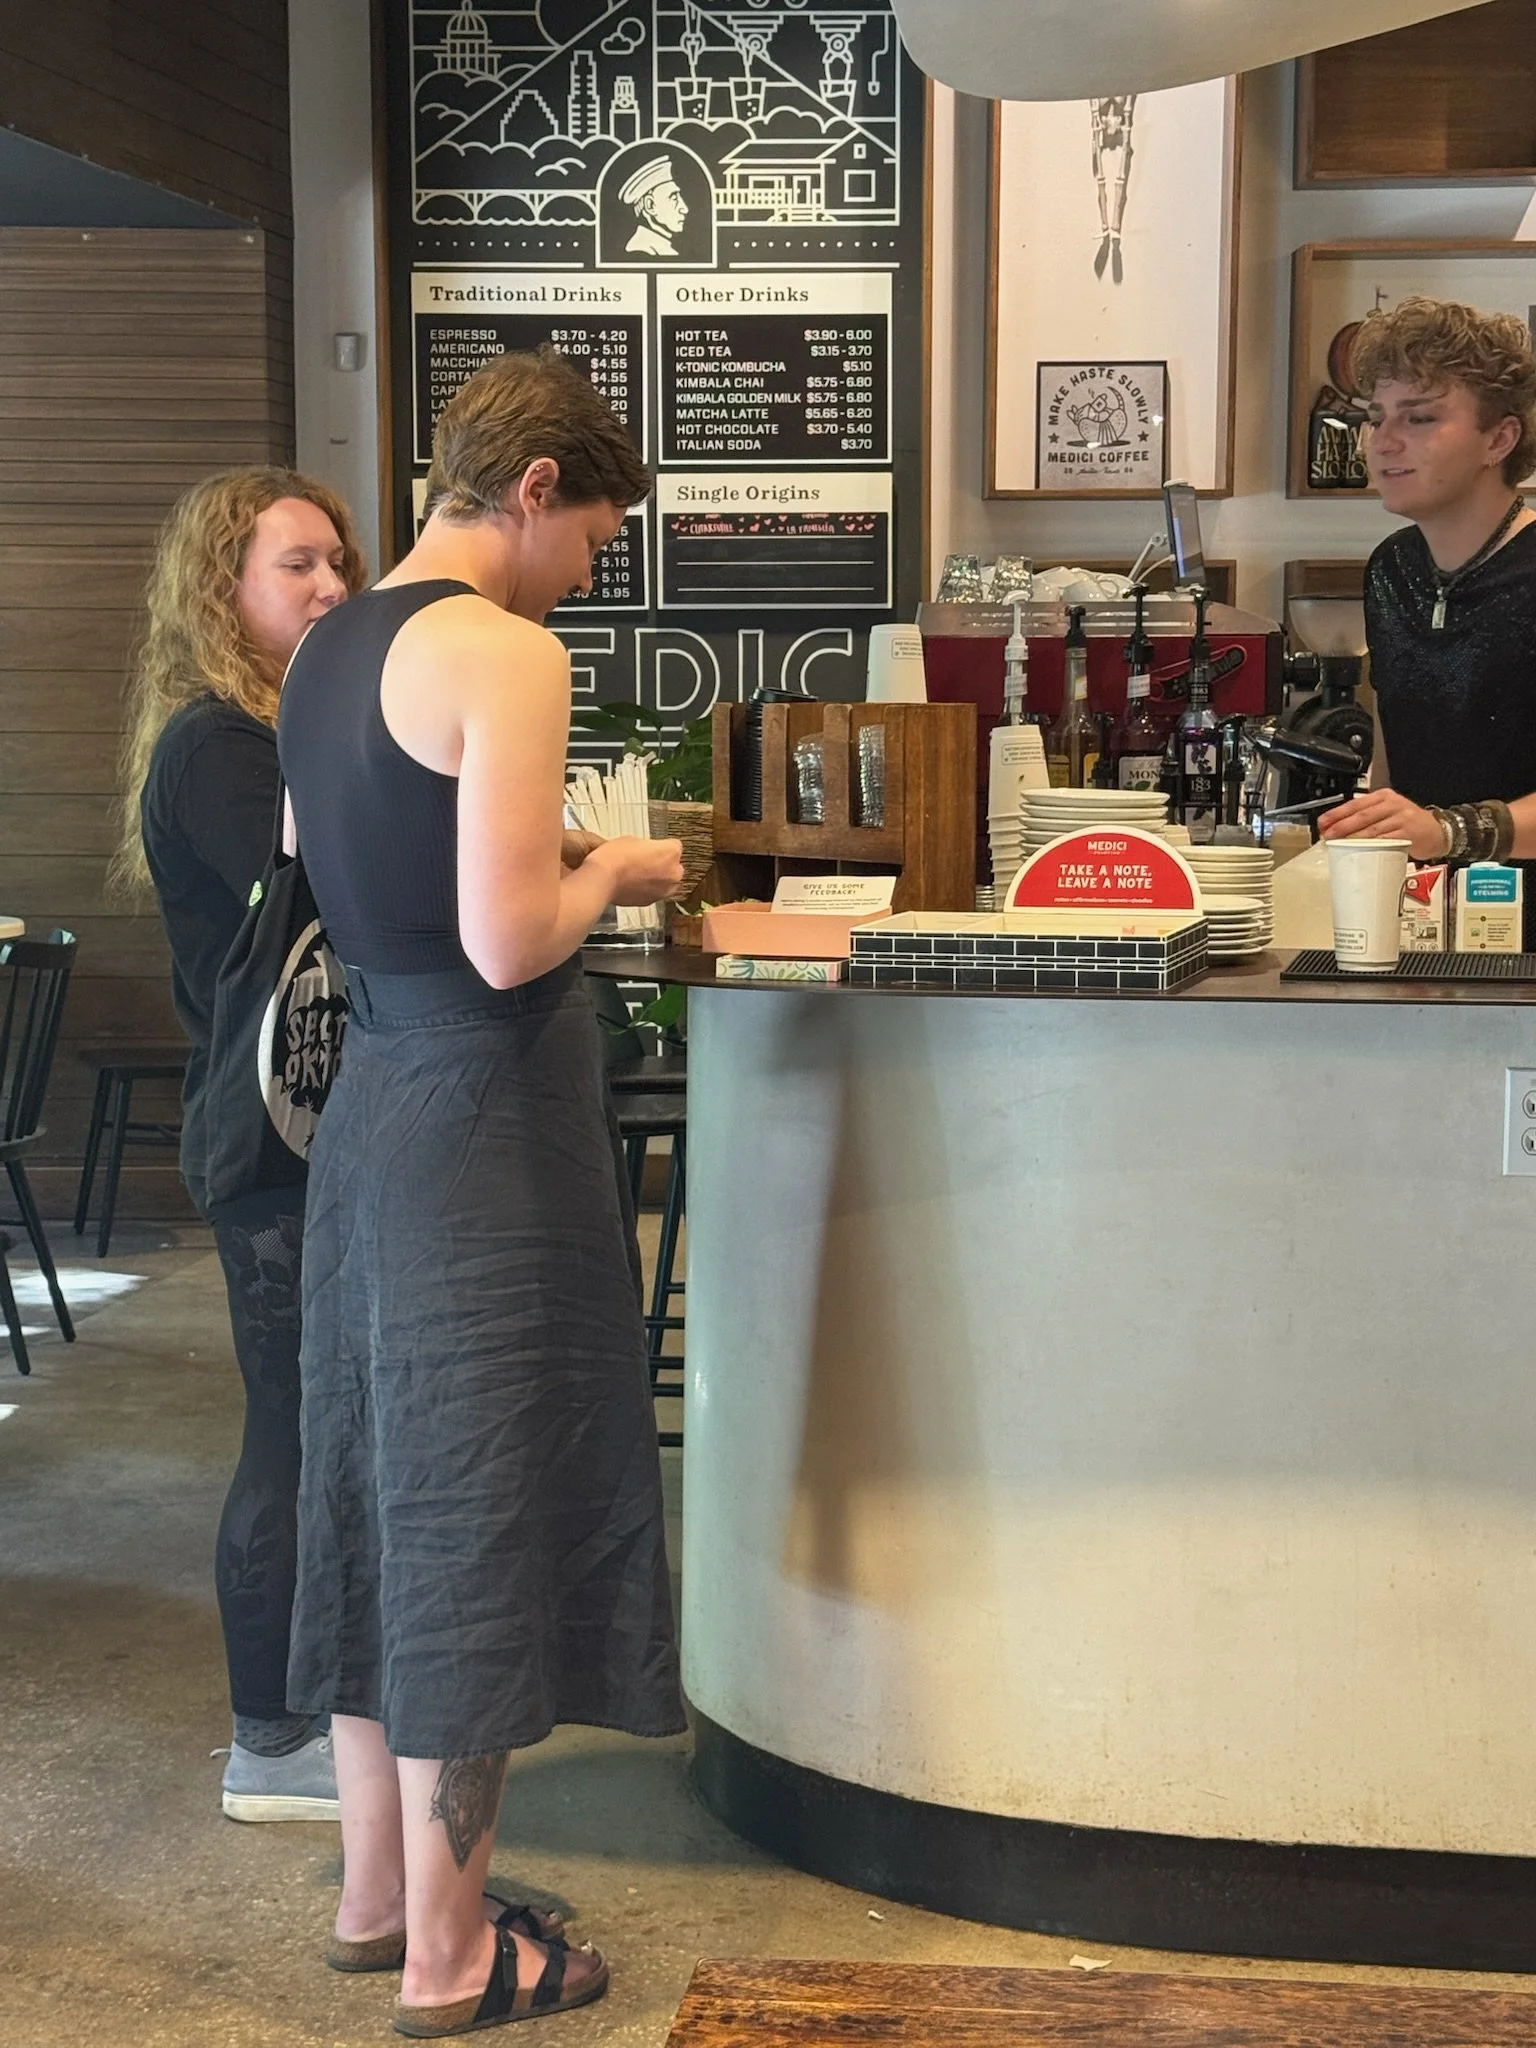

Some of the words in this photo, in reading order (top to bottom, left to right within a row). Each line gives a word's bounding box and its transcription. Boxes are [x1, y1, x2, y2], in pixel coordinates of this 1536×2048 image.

[429, 286, 547, 302] Traditional
[552, 286, 622, 302] Drinks
[676, 287, 734, 302] Other
[739, 286, 809, 302] Drinks
[430, 329, 497, 341] ESPRESSO
[551, 330, 587, 341] $3.70
[598, 330, 628, 341] 4.20
[675, 330, 701, 341] HOT
[704, 330, 729, 341] TEA
[803, 329, 838, 341] $3.90
[845, 329, 873, 341] 6.00
[430, 343, 505, 354] AMERICANO
[553, 343, 591, 355] $4.00
[602, 344, 628, 355] 5.10
[675, 346, 705, 357] ICED
[708, 346, 732, 357] TEA
[810, 345, 840, 357] $3.15
[847, 345, 873, 356] 3.70
[590, 358, 628, 369] $4.55
[675, 361, 720, 373] K-TONIC
[721, 361, 787, 373] KOMBUCHA
[842, 360, 873, 373] $5.10
[430, 371, 477, 382] CORTA
[590, 372, 628, 383] $4.55
[675, 377, 731, 389] KIMBALA
[734, 377, 765, 389] CHAI
[806, 376, 838, 388] $5.75
[846, 376, 873, 388] 6.80
[675, 392, 726, 404] KIMBALA
[727, 392, 773, 404] GOLDEN
[774, 392, 802, 404] MILK
[806, 392, 838, 404] $5.75
[846, 392, 873, 403] 6.80
[1048, 385, 1070, 426] MAKE
[1070, 367, 1115, 387] HASTE
[1118, 374, 1149, 425] SLOWLY
[675, 408, 728, 419] MATCHA
[731, 408, 769, 419] LATTE
[805, 407, 839, 419] $5.65
[846, 408, 873, 419] 6.20
[676, 424, 702, 435] HOT
[705, 424, 779, 435] CHOCOLATE
[806, 423, 839, 435] $3.70
[846, 423, 873, 434] 5.40
[676, 439, 724, 451] ITALIAN
[727, 439, 762, 451] SODA
[841, 438, 873, 450] $3.70
[1048, 452, 1093, 463] MEDICI
[1099, 451, 1149, 463] COFFEE
[677, 485, 740, 504] Single
[745, 485, 820, 504] Origins
[601, 557, 630, 568] 5.10
[601, 572, 631, 583] 5.10
[601, 587, 631, 599] 5.95
[1087, 841, 1127, 851] MEDICI
[1060, 864, 1094, 876] TAKE
[1098, 865, 1108, 876] A
[1057, 877, 1098, 888] LEAVE
[1102, 878, 1111, 889] A
[1117, 878, 1152, 889] NOTE
